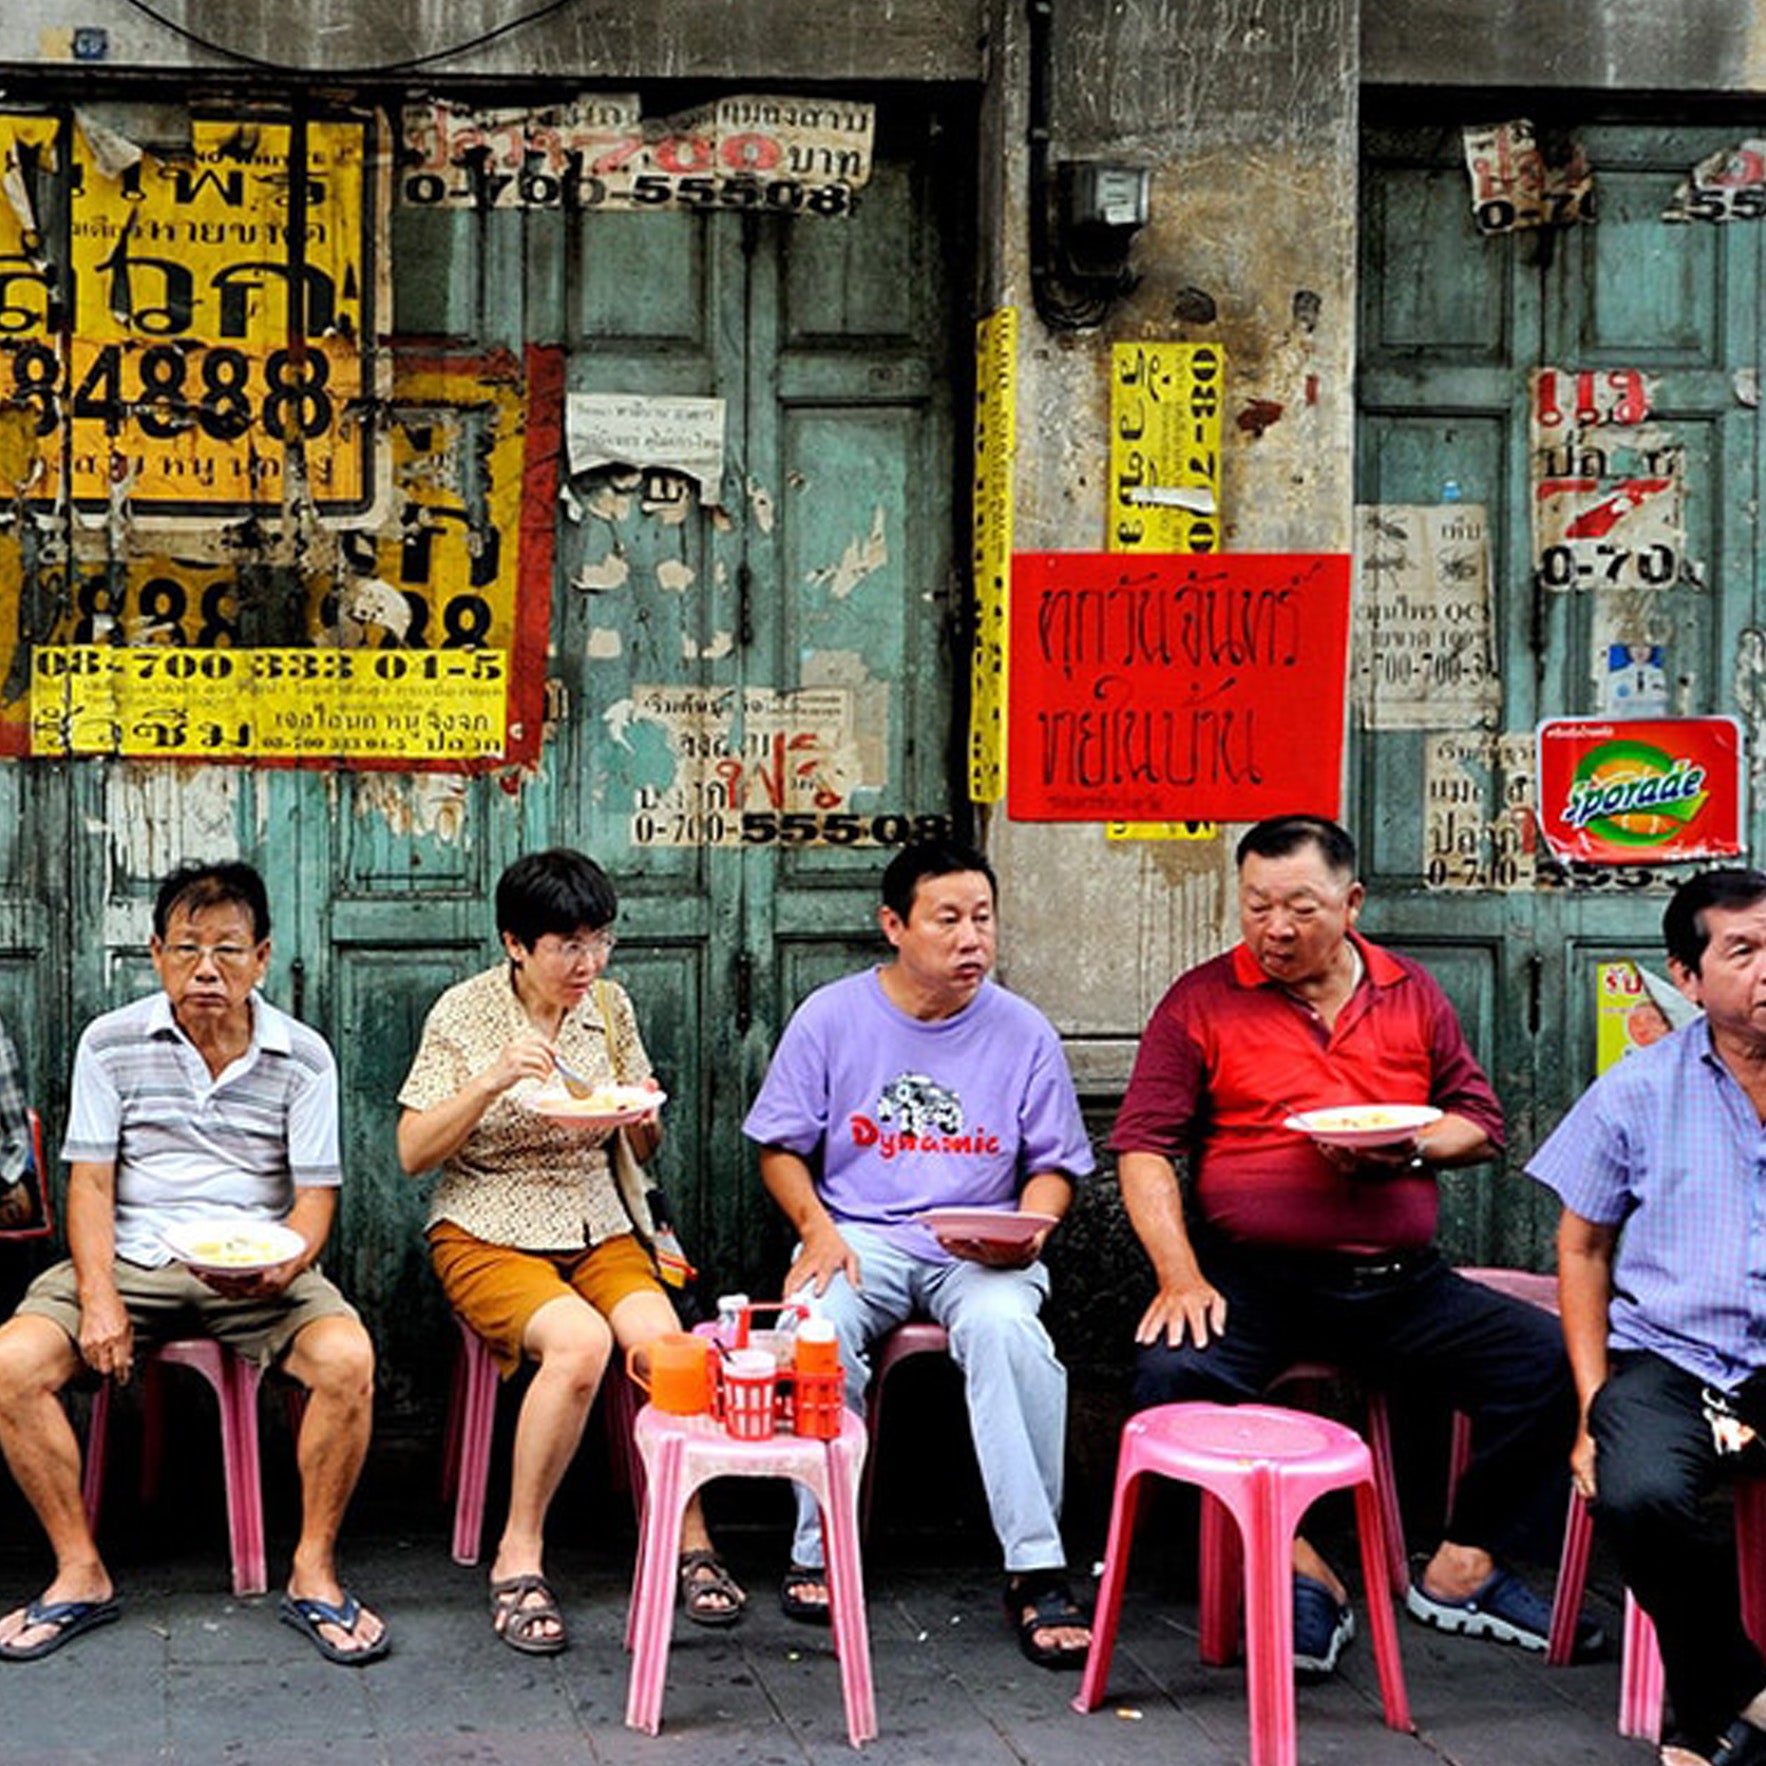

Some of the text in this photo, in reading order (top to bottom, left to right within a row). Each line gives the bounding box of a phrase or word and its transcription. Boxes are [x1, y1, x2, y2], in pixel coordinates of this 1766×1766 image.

[788, 147, 861, 179] บาท
[251, 653, 354, 678] 333
[374, 654, 502, 680] 01-5
[851, 1115, 1000, 1159] Dynamic
